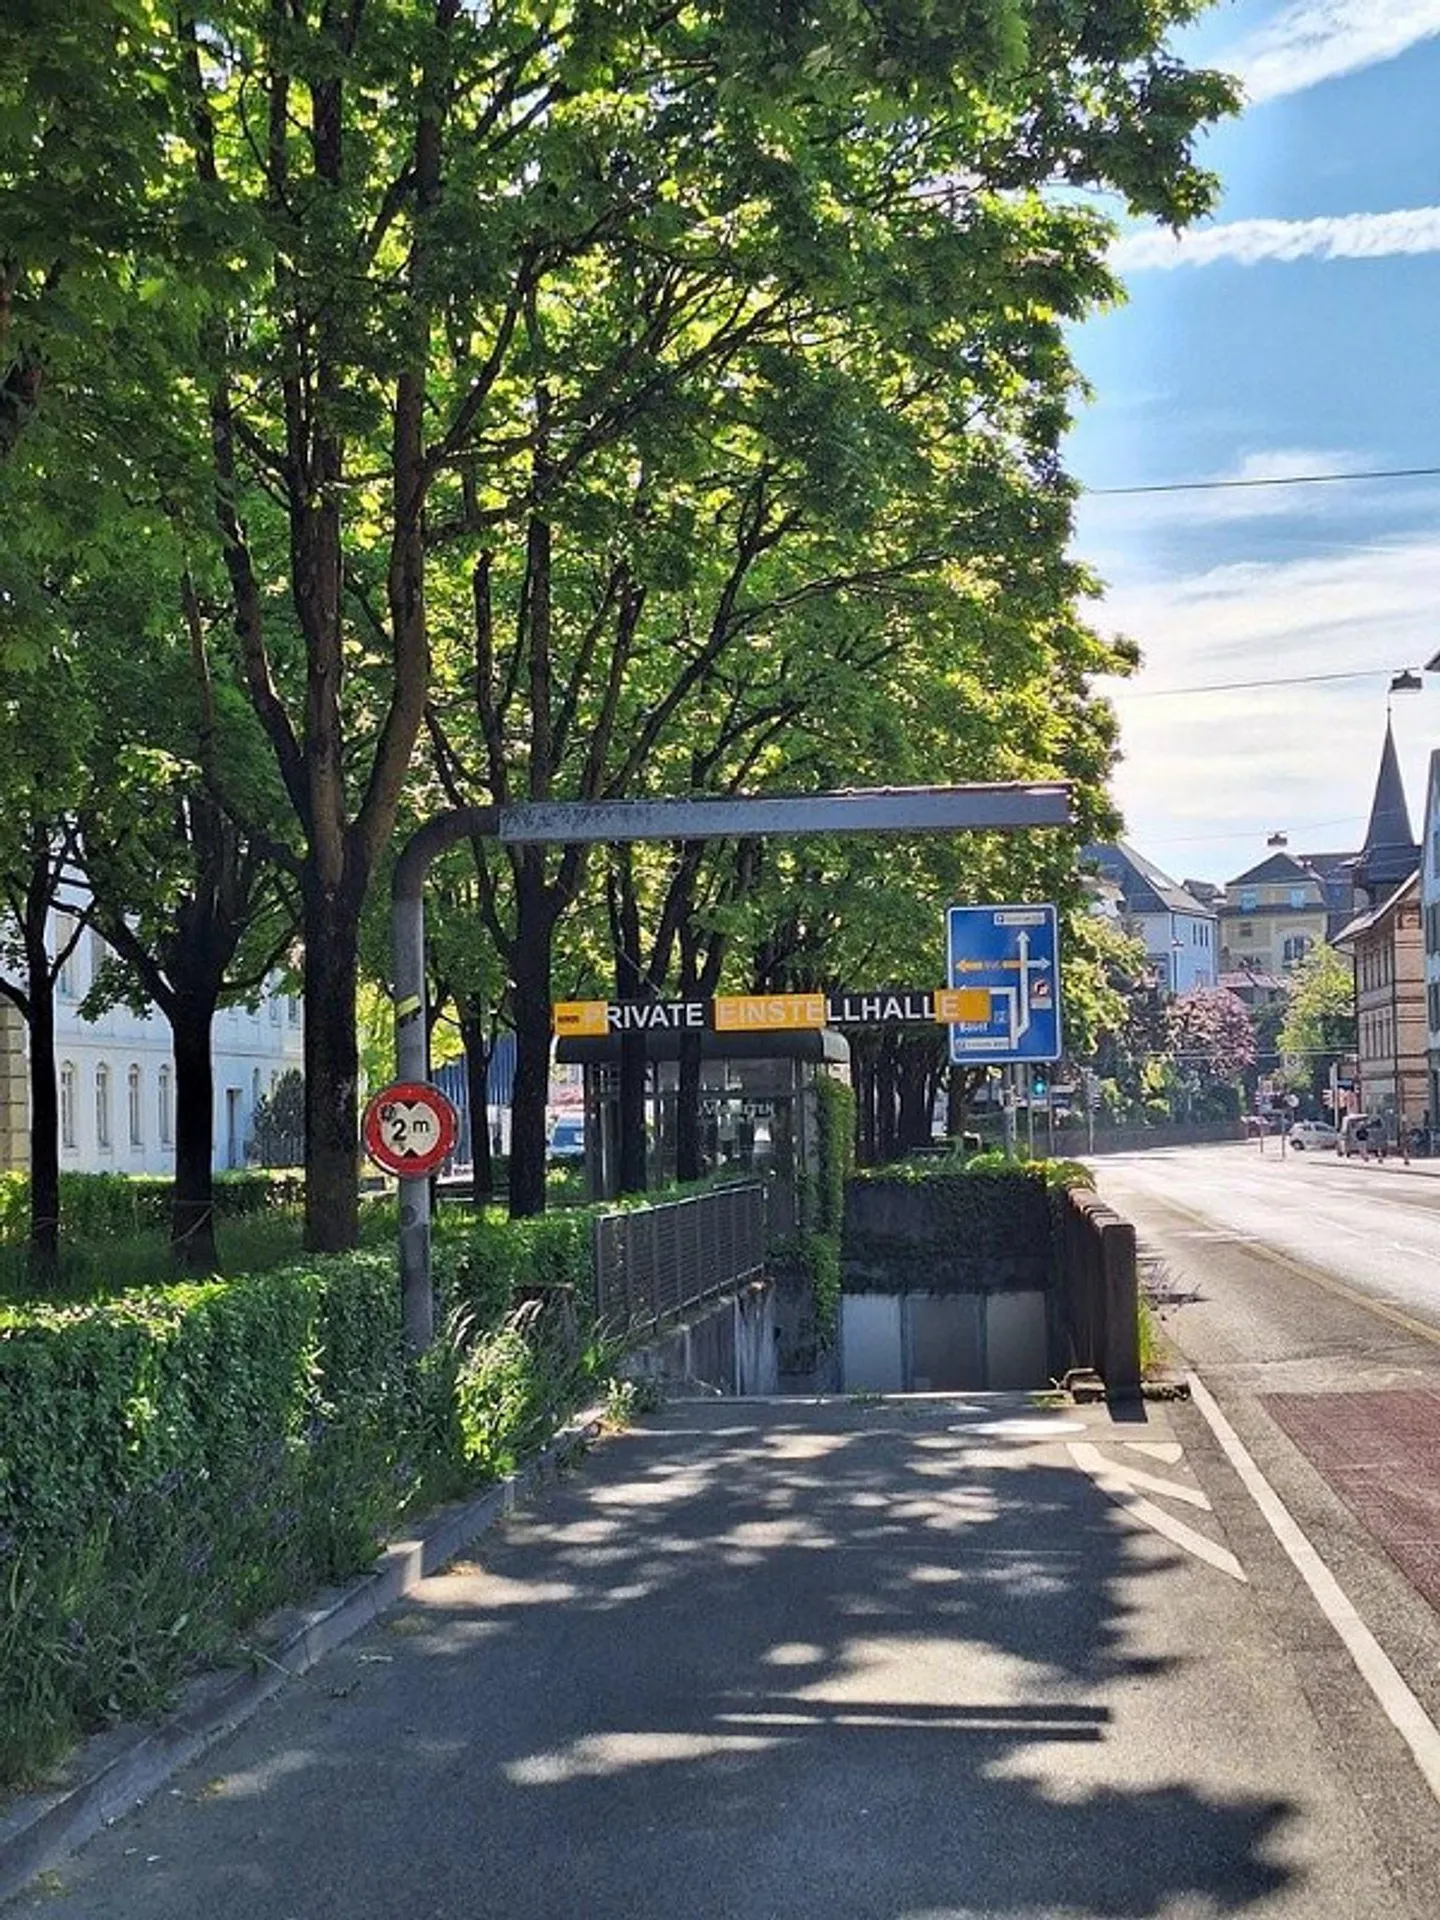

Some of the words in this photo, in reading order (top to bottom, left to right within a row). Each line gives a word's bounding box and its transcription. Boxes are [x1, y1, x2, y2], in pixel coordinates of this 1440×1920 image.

[584, 1002, 704, 1028] PRIVATE
[719, 996, 960, 1024] EINSTELLHALLE
[392, 1119, 407, 1141] 2
[413, 1120, 429, 1132] m
